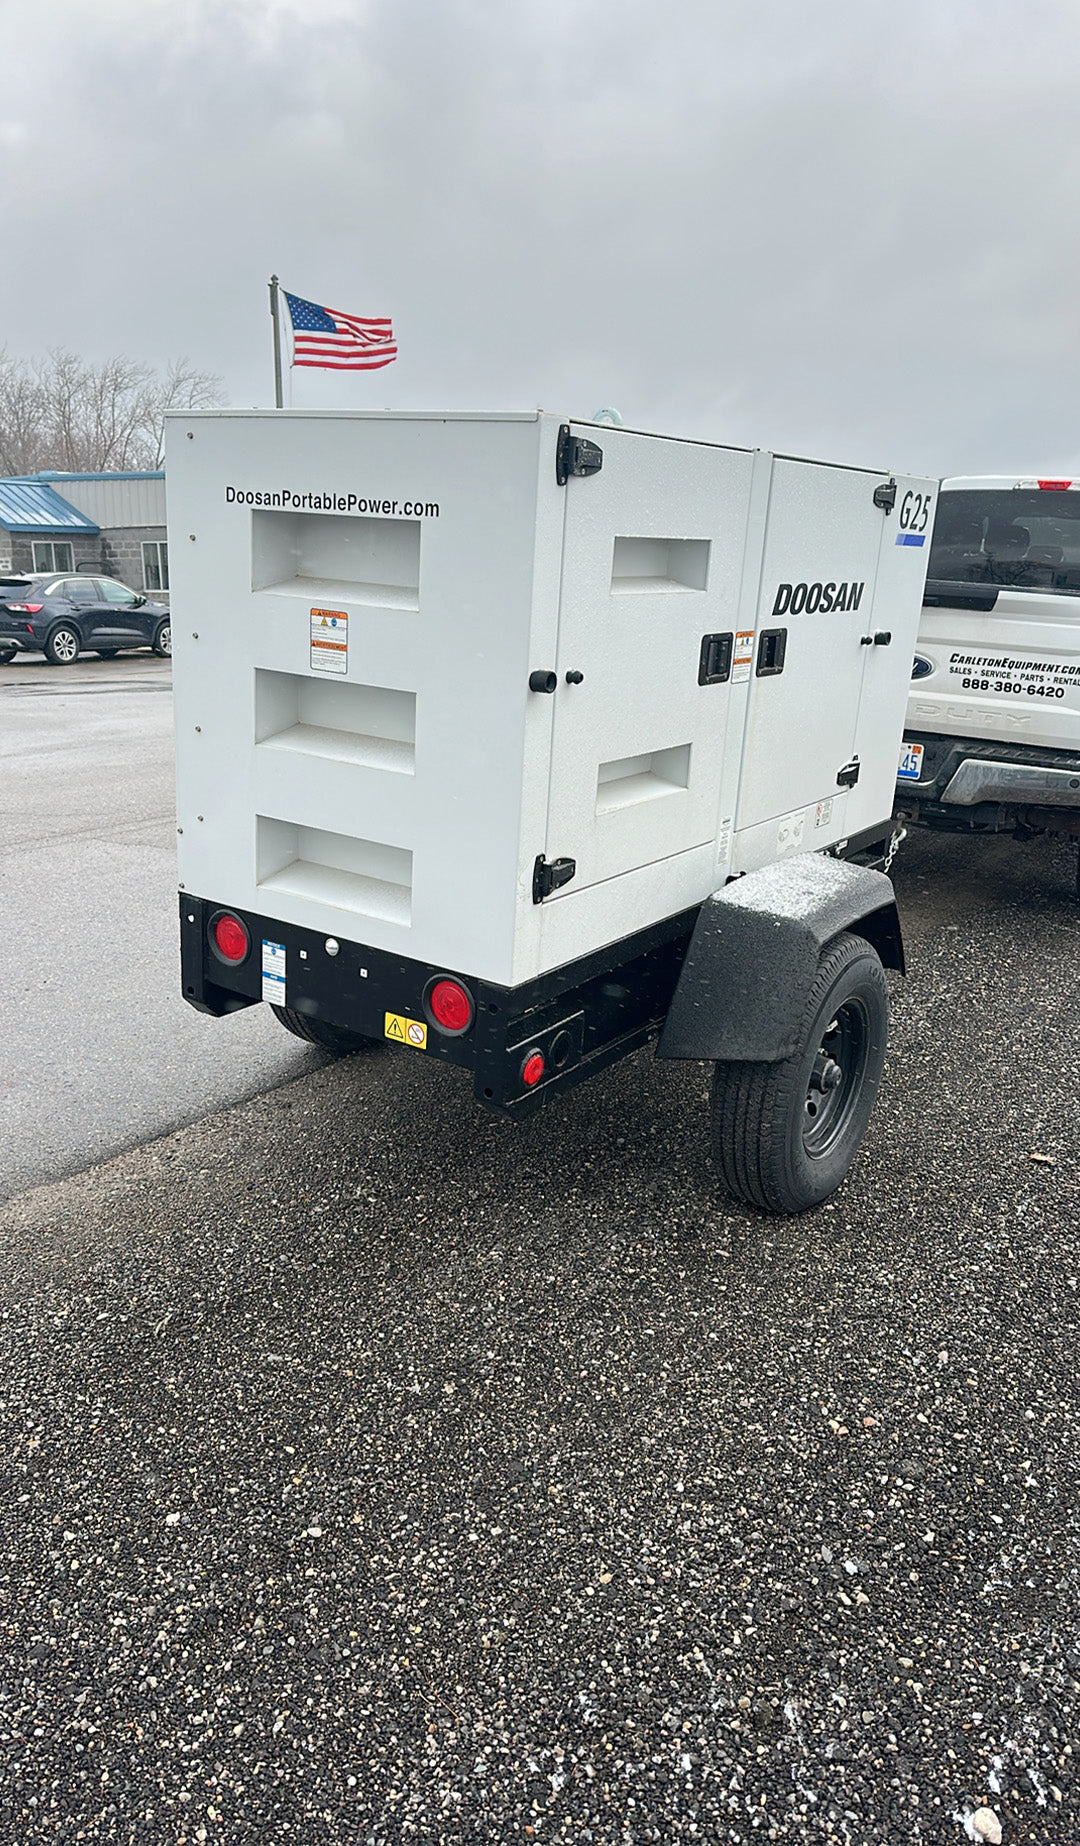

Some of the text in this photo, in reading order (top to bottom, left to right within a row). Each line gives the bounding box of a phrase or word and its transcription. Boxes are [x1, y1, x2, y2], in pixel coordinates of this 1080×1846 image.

[226, 486, 440, 517] DoosanPortablePower.com
[899, 490, 931, 532] G25
[772, 582, 864, 616] DOOSAN
[949, 666, 972, 676] SALES
[980, 669, 1012, 680] SERVICE
[1020, 673, 1044, 683] PARTS
[962, 678, 1065, 699] 888-380-6420
[915, 704, 1031, 727] DUTY
[898, 754, 918, 771] 45
